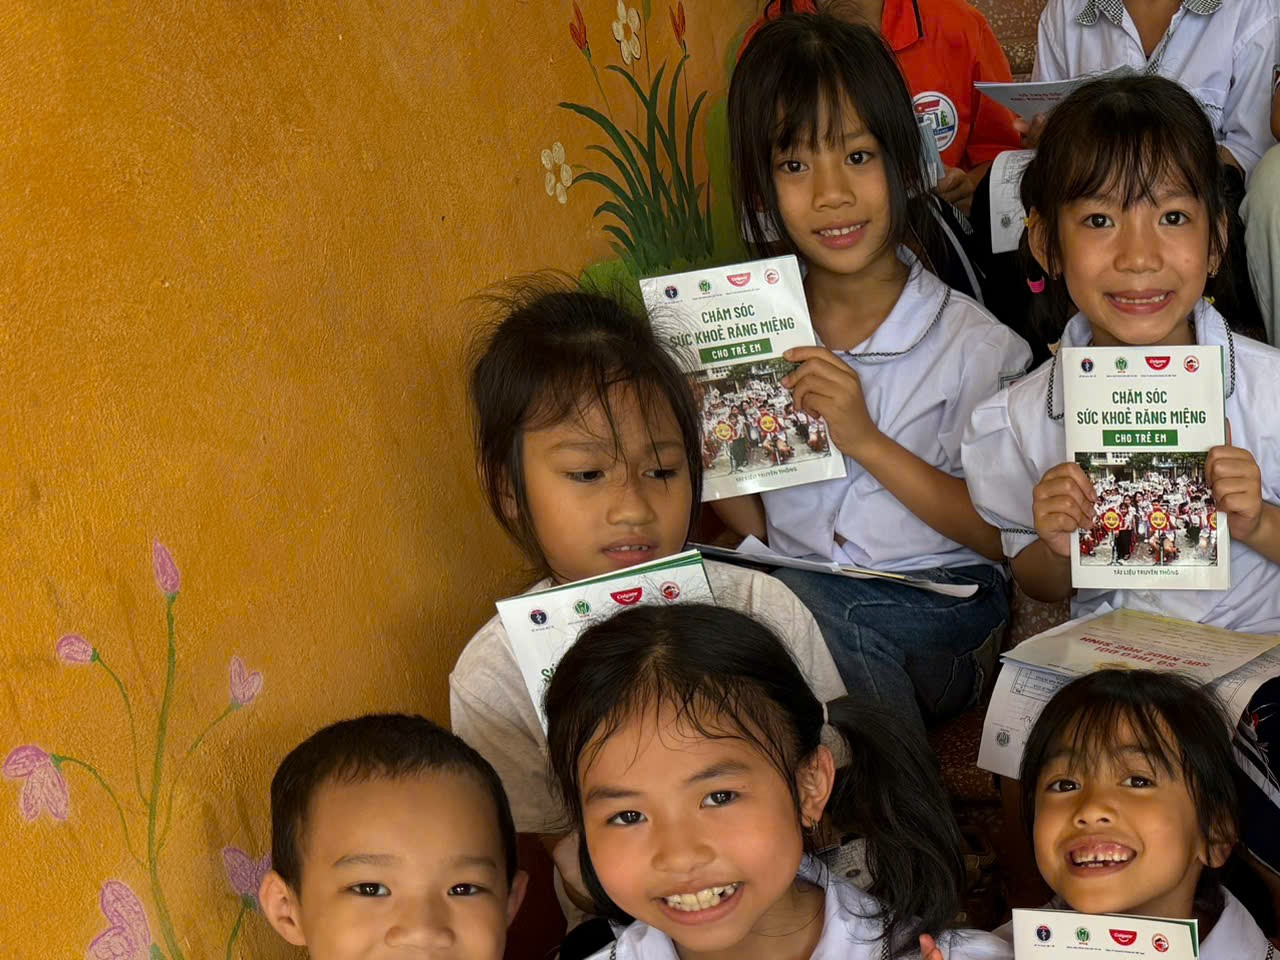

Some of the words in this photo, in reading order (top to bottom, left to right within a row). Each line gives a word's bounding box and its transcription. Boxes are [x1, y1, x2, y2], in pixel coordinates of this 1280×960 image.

[701, 306, 732, 324] CHĂM
[734, 302, 755, 320] SÓC
[670, 332, 693, 348] SỨC
[695, 324, 725, 345] KHOẺ
[728, 322, 757, 339] RĂNG
[760, 316, 795, 336] MIỆNG
[711, 349, 728, 360] CHO
[731, 346, 747, 357] TRẺ
[750, 344, 762, 354] EM
[1112, 389, 1142, 404] CHĂM
[1146, 388, 1167, 403] SÓC
[1077, 408, 1098, 425] SỨC
[1102, 407, 1132, 424] KHOẺ
[1135, 408, 1167, 424] RĂNG
[1170, 407, 1206, 428] MIỆNG
[1115, 434, 1131, 442] CHO
[1135, 432, 1152, 442] TRẺ
[1155, 434, 1167, 442] EM
